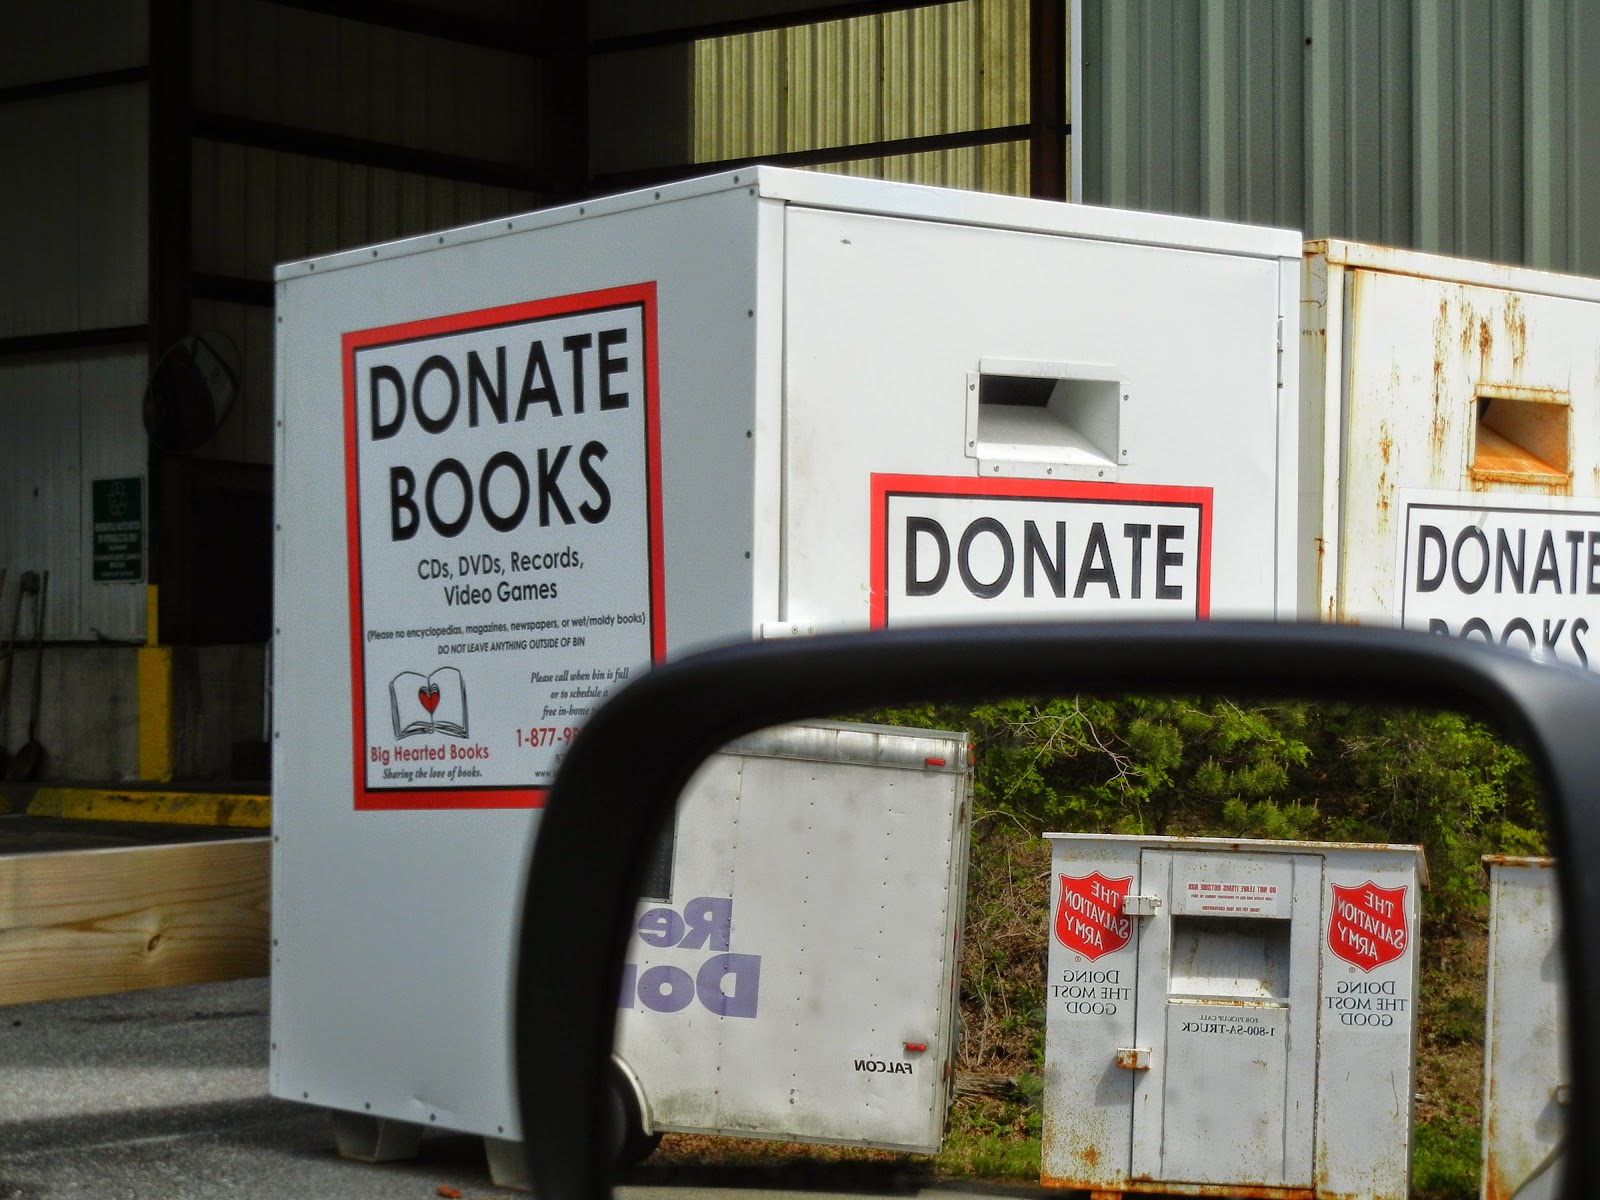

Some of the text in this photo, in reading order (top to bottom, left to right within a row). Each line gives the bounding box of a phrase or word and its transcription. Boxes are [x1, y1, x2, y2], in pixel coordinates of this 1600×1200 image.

[370, 328, 629, 441] DONATE
[390, 440, 611, 542] BOOKS
[417, 546, 584, 580] CDs, DVDs, Records,
[906, 516, 1185, 600] DONATE
[1416, 525, 1600, 595] DONATE
[444, 581, 557, 606] Video Games
[367, 612, 646, 643] (Please no encyclopedias, magazines, newspapers, or wet/moldy books)
[438, 637, 585, 655] DO NOT LEAVE ANYTHING OUTSIDE OF BIN
[530, 667, 629, 683] Please call when bin is full
[550, 691, 559, 699] or
[560, 689, 568, 698] to
[569, 686, 602, 698] schedule
[541, 705, 557, 720] free
[558, 704, 590, 716] in-home
[371, 743, 489, 766] Big Hearted Books
[383, 766, 482, 782] Sharing the love of books.
